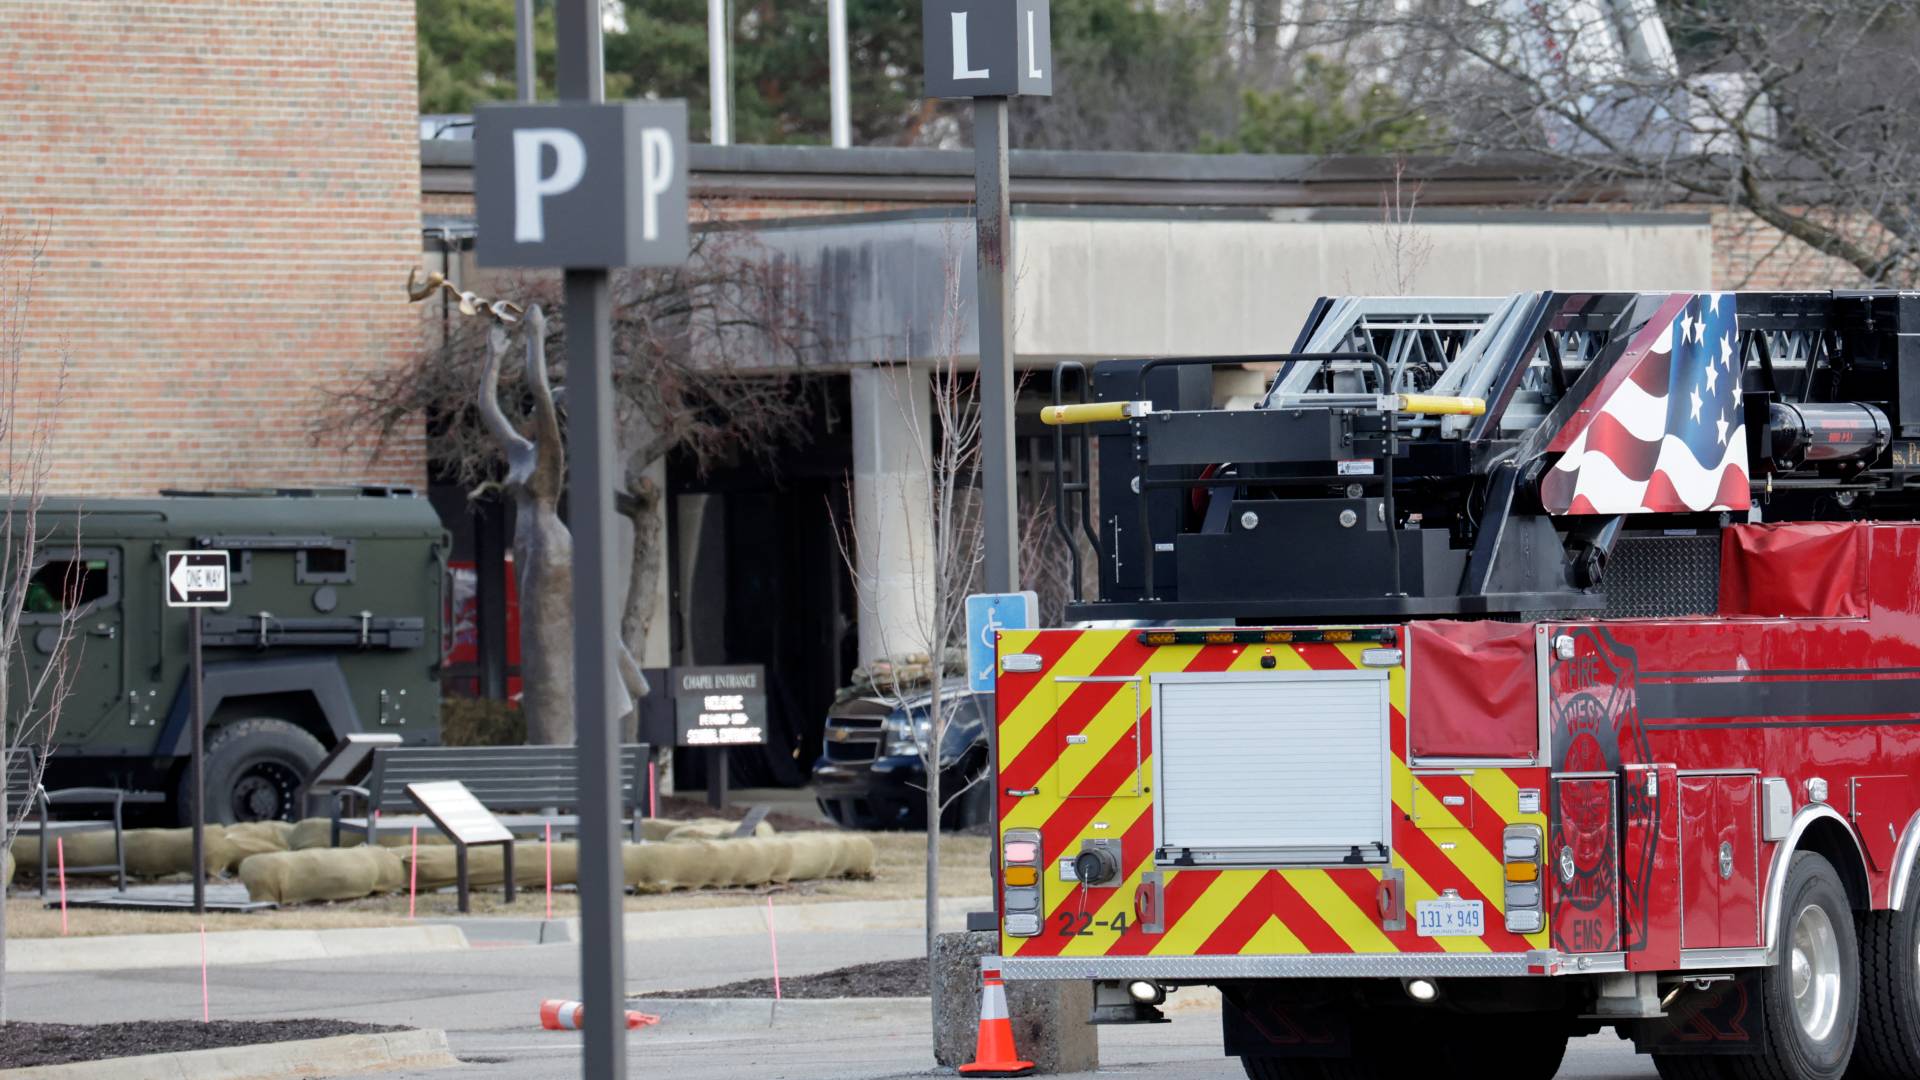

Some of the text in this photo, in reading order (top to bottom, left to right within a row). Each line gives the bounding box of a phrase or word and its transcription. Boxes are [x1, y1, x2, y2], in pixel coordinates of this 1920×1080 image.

[950, 11, 990, 80] L
[1026, 10, 1042, 79] L
[512, 127, 588, 243] P
[641, 127, 674, 241] P
[186, 568, 222, 588] ONE WAY
[682, 672, 757, 690] CHAPEL ENTRANCE
[1568, 655, 1600, 687] FIRE
[1563, 699, 1604, 737] WEST
[1058, 911, 1130, 937] 22-4
[1420, 910, 1442, 928] 131
[1457, 910, 1480, 928] 949
[1573, 918, 1603, 950] EMS
